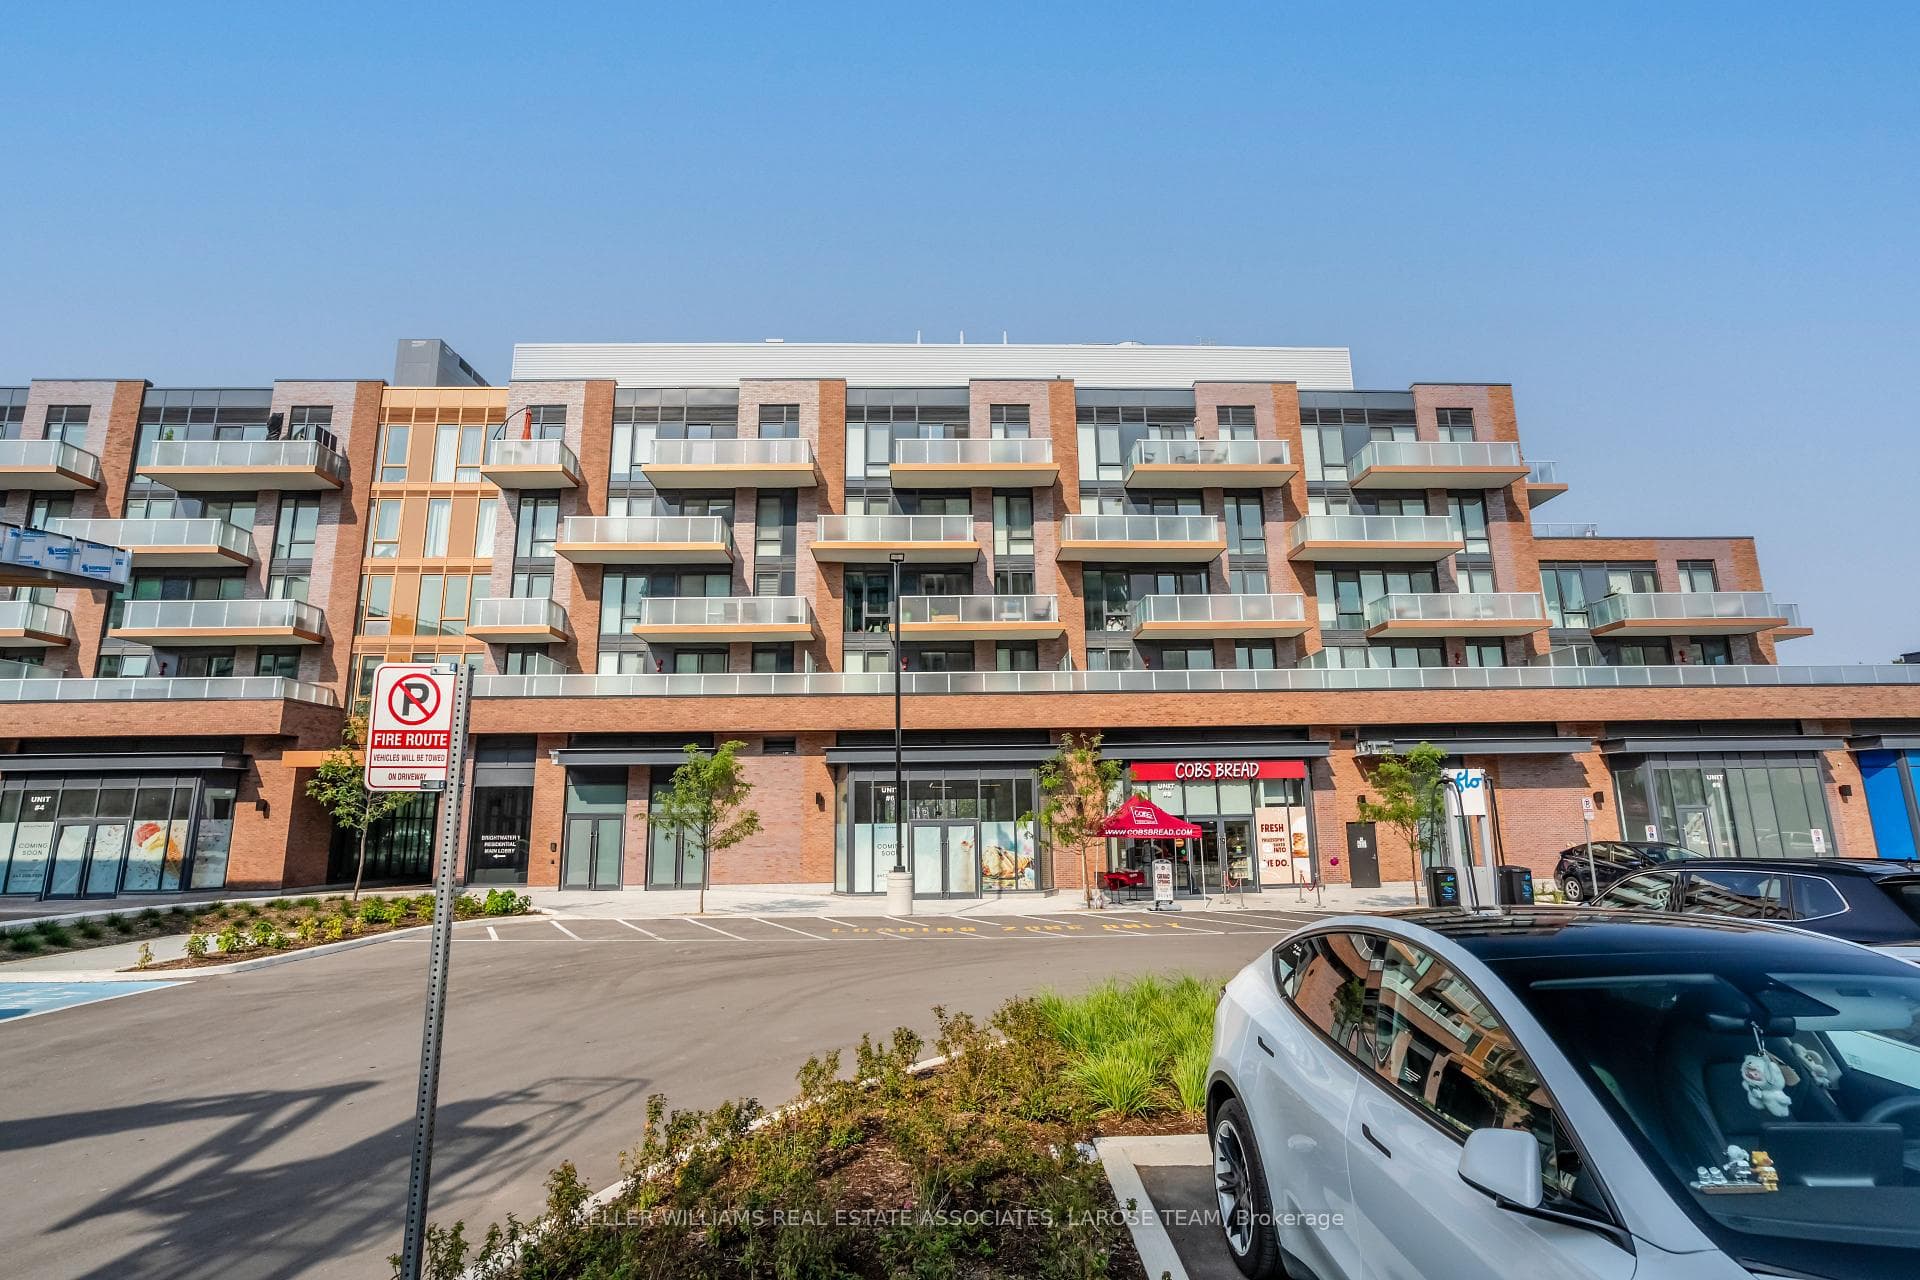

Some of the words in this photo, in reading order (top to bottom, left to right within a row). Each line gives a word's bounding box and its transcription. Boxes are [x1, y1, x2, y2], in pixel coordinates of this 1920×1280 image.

[374, 733, 402, 746] FIRE
[405, 733, 448, 746] ROUTE
[373, 754, 400, 762] VEHICLES
[401, 754, 415, 762] WILL
[416, 754, 424, 762] BE
[425, 754, 446, 762] TOWED
[1175, 762, 1212, 779] COBS
[1215, 761, 1260, 778] BREAD
[388, 773, 396, 781] ON
[397, 772, 428, 780] DRIVEWAY
[1455, 767, 1483, 793] flo
[1260, 823, 1284, 833] FRESH
